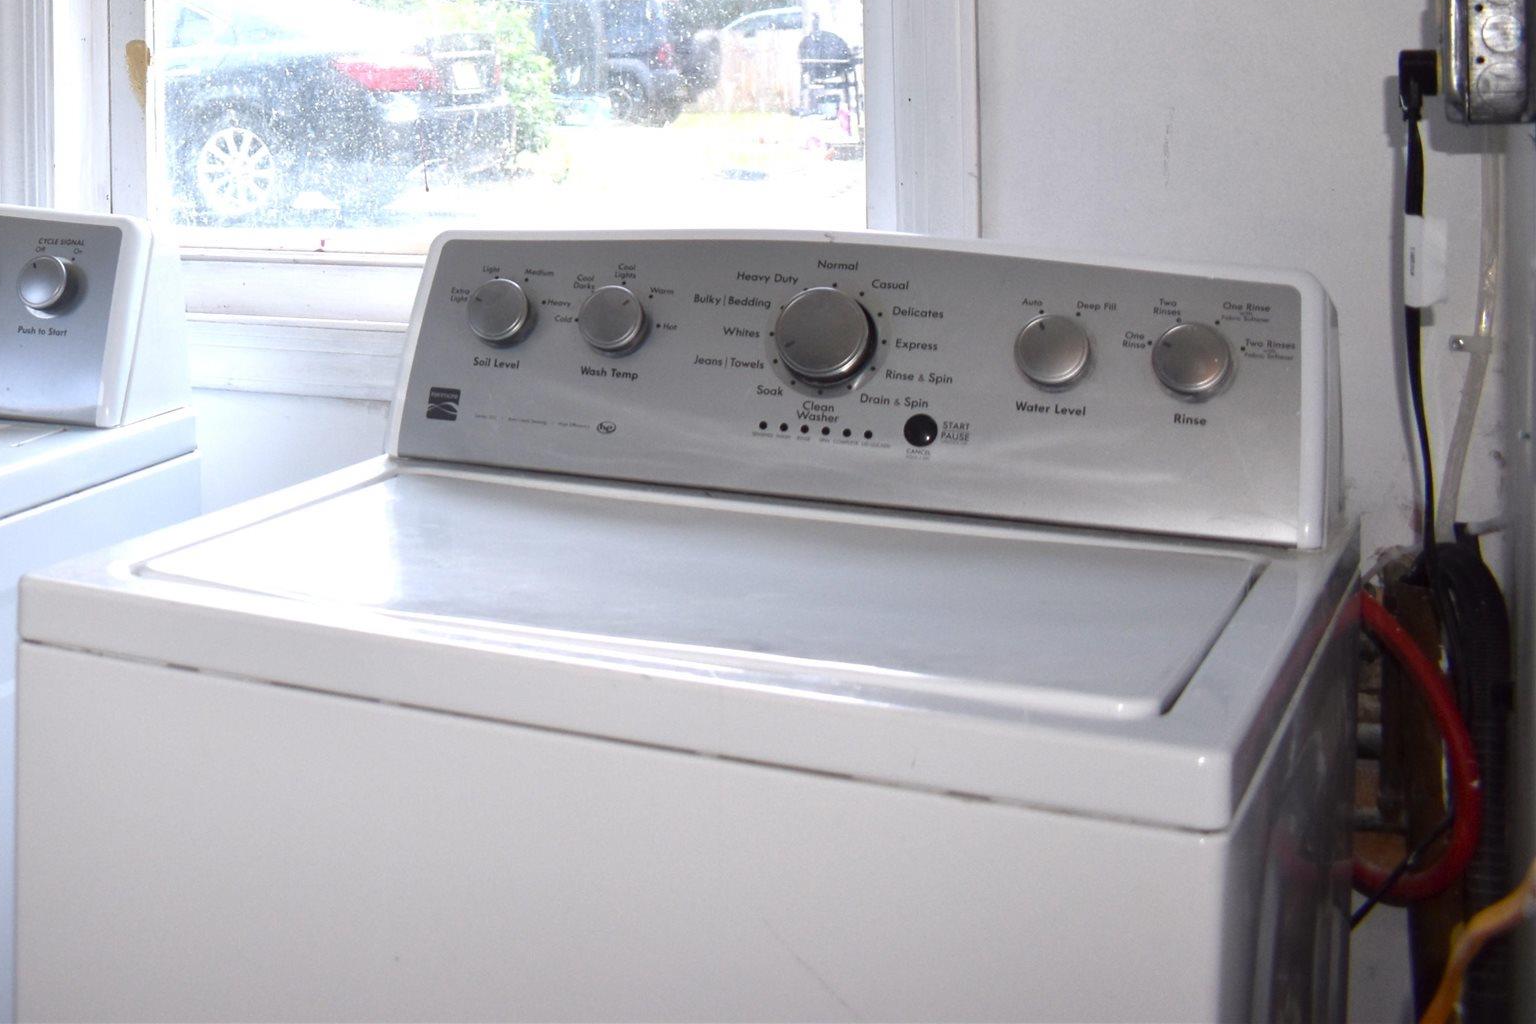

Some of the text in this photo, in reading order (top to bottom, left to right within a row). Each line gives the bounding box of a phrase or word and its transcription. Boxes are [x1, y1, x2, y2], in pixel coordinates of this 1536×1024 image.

[38, 237, 84, 246] CYCLE SIGNAL
[482, 265, 501, 274] Light
[618, 263, 636, 271] Cool
[817, 260, 858, 271] Normal
[576, 274, 595, 282] Cool
[737, 272, 798, 285] Heavy Duty
[871, 279, 909, 290] Casual
[451, 287, 470, 295] Extra
[547, 299, 572, 307] Heavy
[694, 294, 771, 309] Bulky Bedding
[1022, 298, 1043, 306] Auto
[1076, 301, 1117, 310] Deep Fill
[1159, 298, 1177, 307] Two
[1222, 301, 1271, 312] One Rinse
[892, 306, 944, 319] Delicates
[1153, 307, 1181, 316] Rinses
[554, 315, 573, 323] Cold
[17, 326, 36, 335] Push
[48, 329, 67, 337] Start
[723, 327, 760, 338] Whites
[1125, 331, 1145, 340] One
[895, 338, 938, 351] Express
[1122, 340, 1146, 349] Rinse
[1245, 338, 1296, 349] Two Rinses
[473, 357, 520, 369] Soil Level
[694, 355, 764, 369] Jeans Towels
[580, 366, 639, 381] Wash Temp
[885, 369, 914, 381] Rinse
[928, 373, 953, 385] Spin
[756, 385, 783, 396] Soak
[803, 401, 835, 412] Clean
[860, 393, 890, 405] Drain
[904, 397, 929, 409] Spin
[1015, 401, 1086, 416] Water Level
[797, 411, 839, 423] Washer
[1173, 413, 1207, 426] Rinse
[943, 421, 969, 430] START
[941, 432, 969, 441] PAUSE
